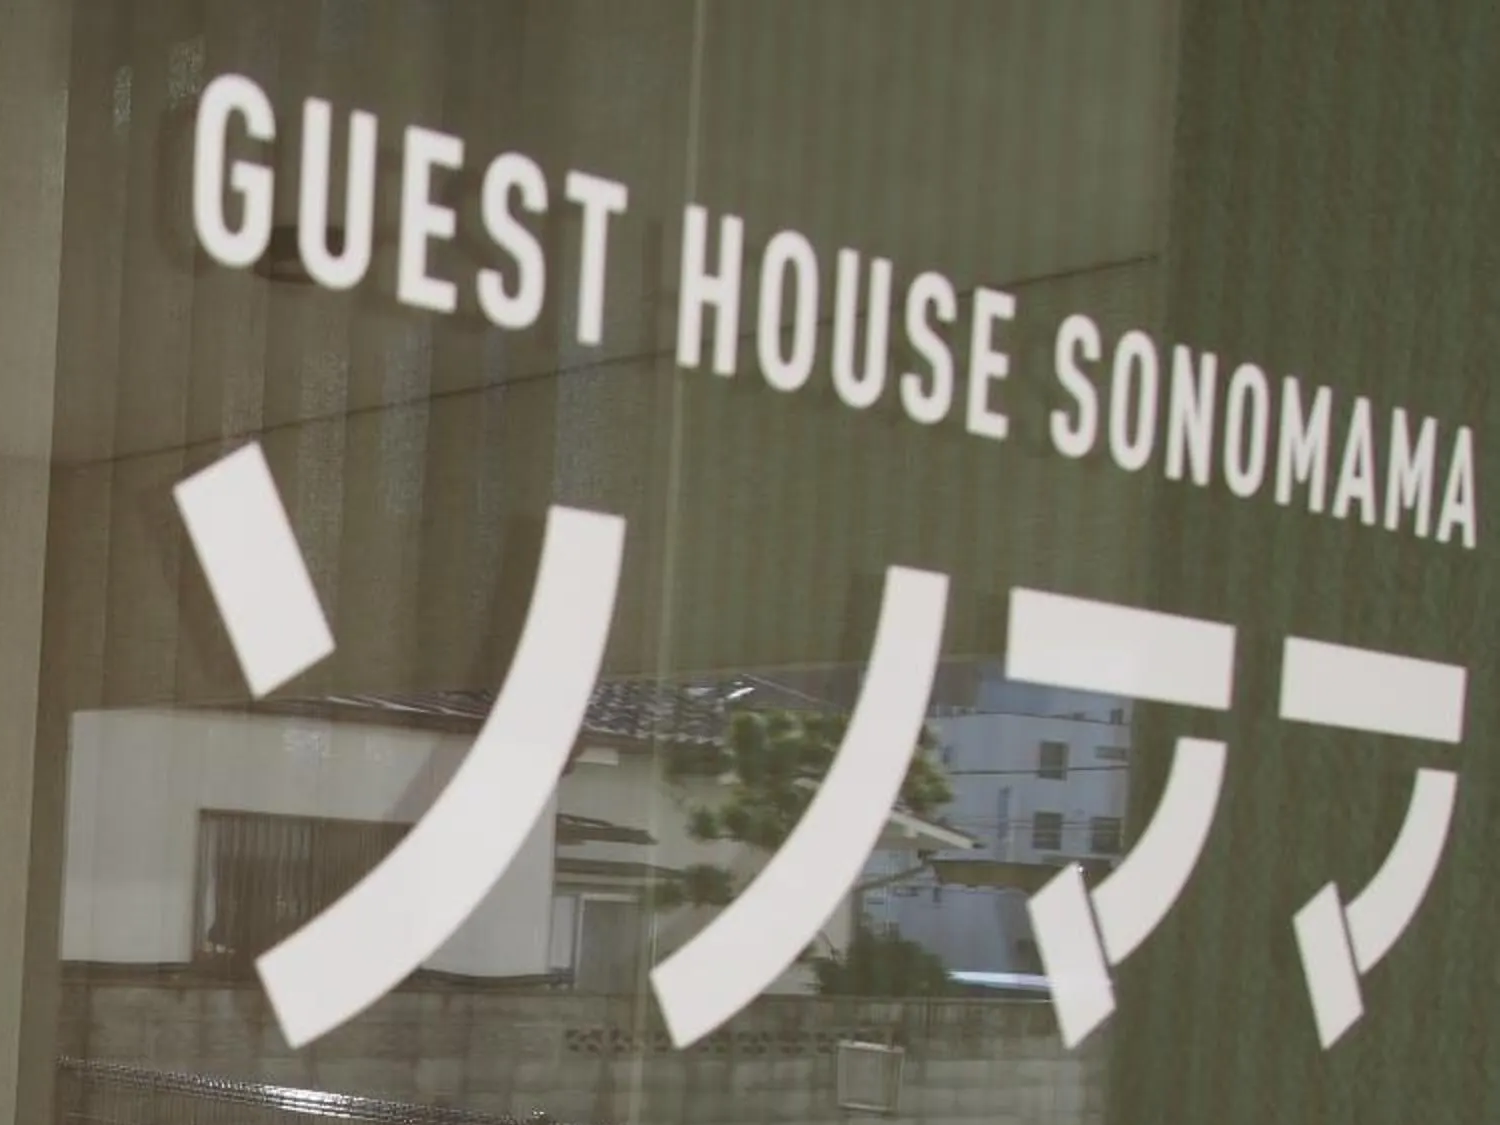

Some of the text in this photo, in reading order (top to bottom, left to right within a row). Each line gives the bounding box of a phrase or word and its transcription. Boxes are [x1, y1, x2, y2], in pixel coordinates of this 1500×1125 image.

[193, 73, 1478, 549] GUEST HOUSE SONOMAMA
